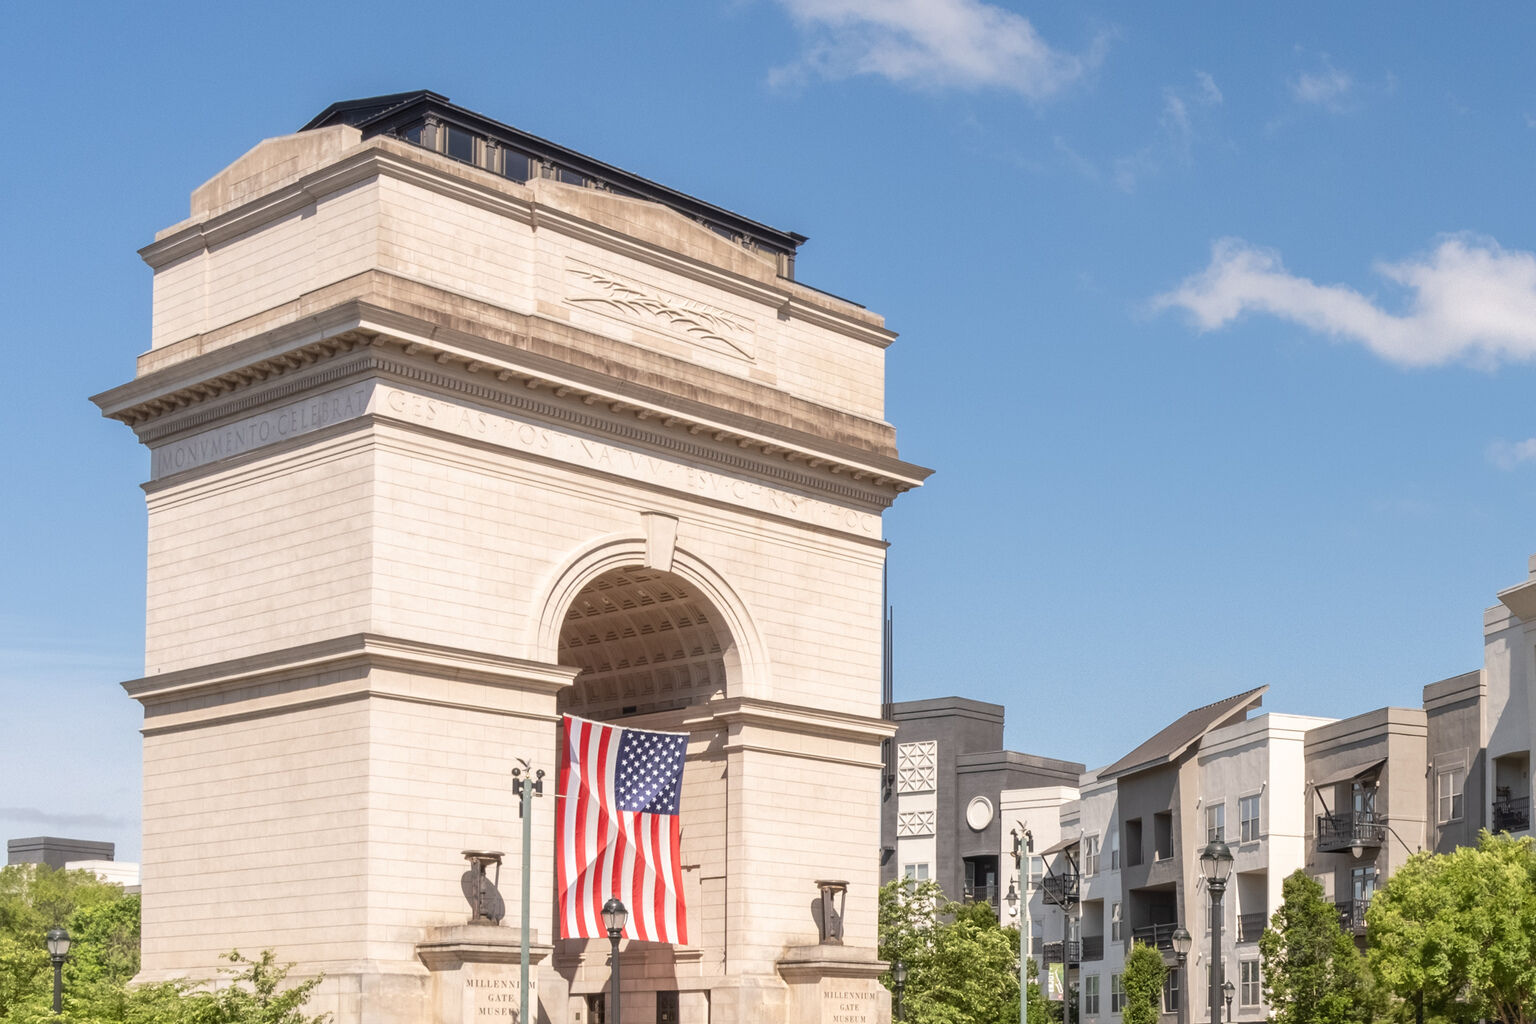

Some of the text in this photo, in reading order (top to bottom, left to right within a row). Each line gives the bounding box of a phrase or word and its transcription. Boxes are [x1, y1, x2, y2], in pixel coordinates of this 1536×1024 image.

[466, 979, 535, 989] MILLENNIM
[488, 994, 514, 1002] GATE
[824, 991, 875, 1000] MILLENNIUM
[833, 1015, 866, 1023] MUSEUM
